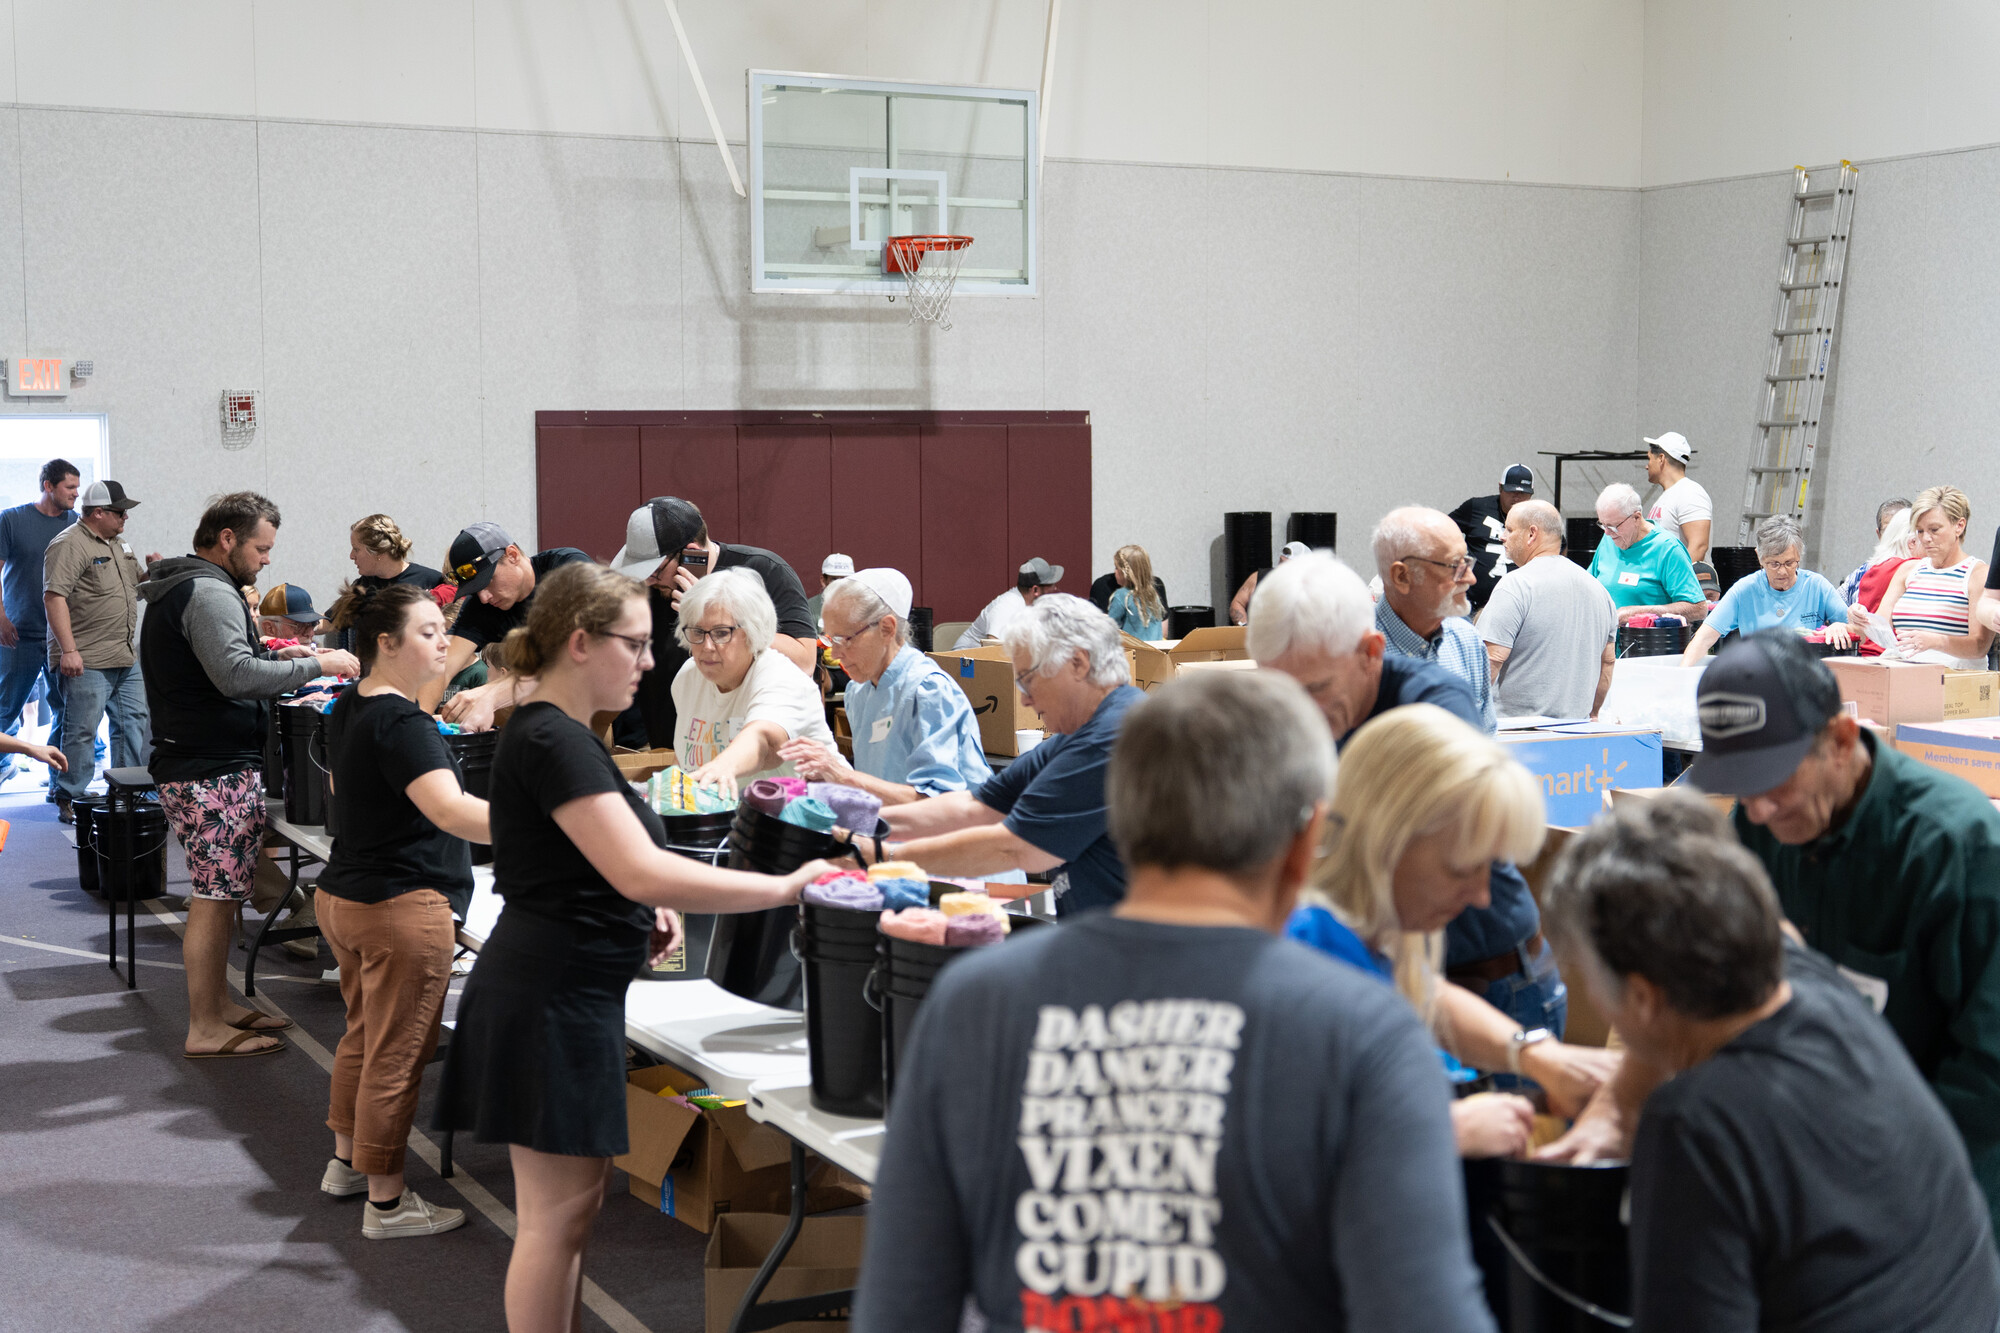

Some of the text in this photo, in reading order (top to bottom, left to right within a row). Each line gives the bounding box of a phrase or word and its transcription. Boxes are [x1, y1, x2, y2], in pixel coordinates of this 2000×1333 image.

[18, 358, 63, 391] EXIT
[684, 717, 722, 744] ET ME
[684, 742, 704, 767] YOU
[1924, 751, 1969, 766] Members
[1971, 759, 1993, 769] save
[1034, 998, 1246, 1050] DASHER
[1024, 1047, 1235, 1096] DANCER
[1019, 1093, 1226, 1138] PRANCER
[1016, 1133, 1222, 1194] VIXEN
[1015, 1189, 1223, 1246] COMET
[1015, 1240, 1227, 1302] CUPID
